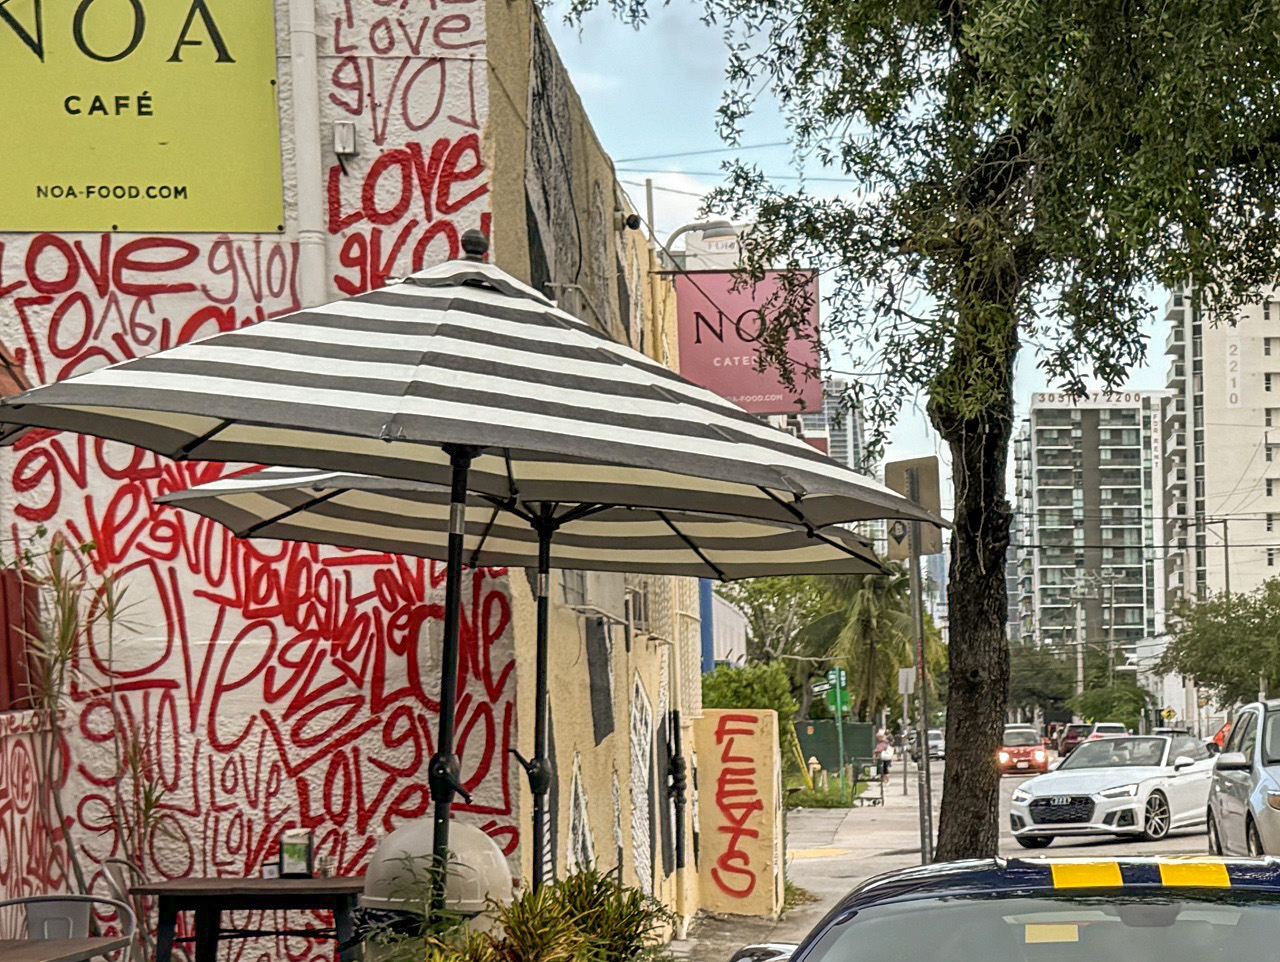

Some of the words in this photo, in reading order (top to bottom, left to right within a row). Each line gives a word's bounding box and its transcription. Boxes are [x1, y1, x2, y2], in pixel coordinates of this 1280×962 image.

[0, 0, 237, 64] NOA
[64, 90, 154, 117] CAFÉ
[36, 185, 188, 200] NOA-FOOD.COM
